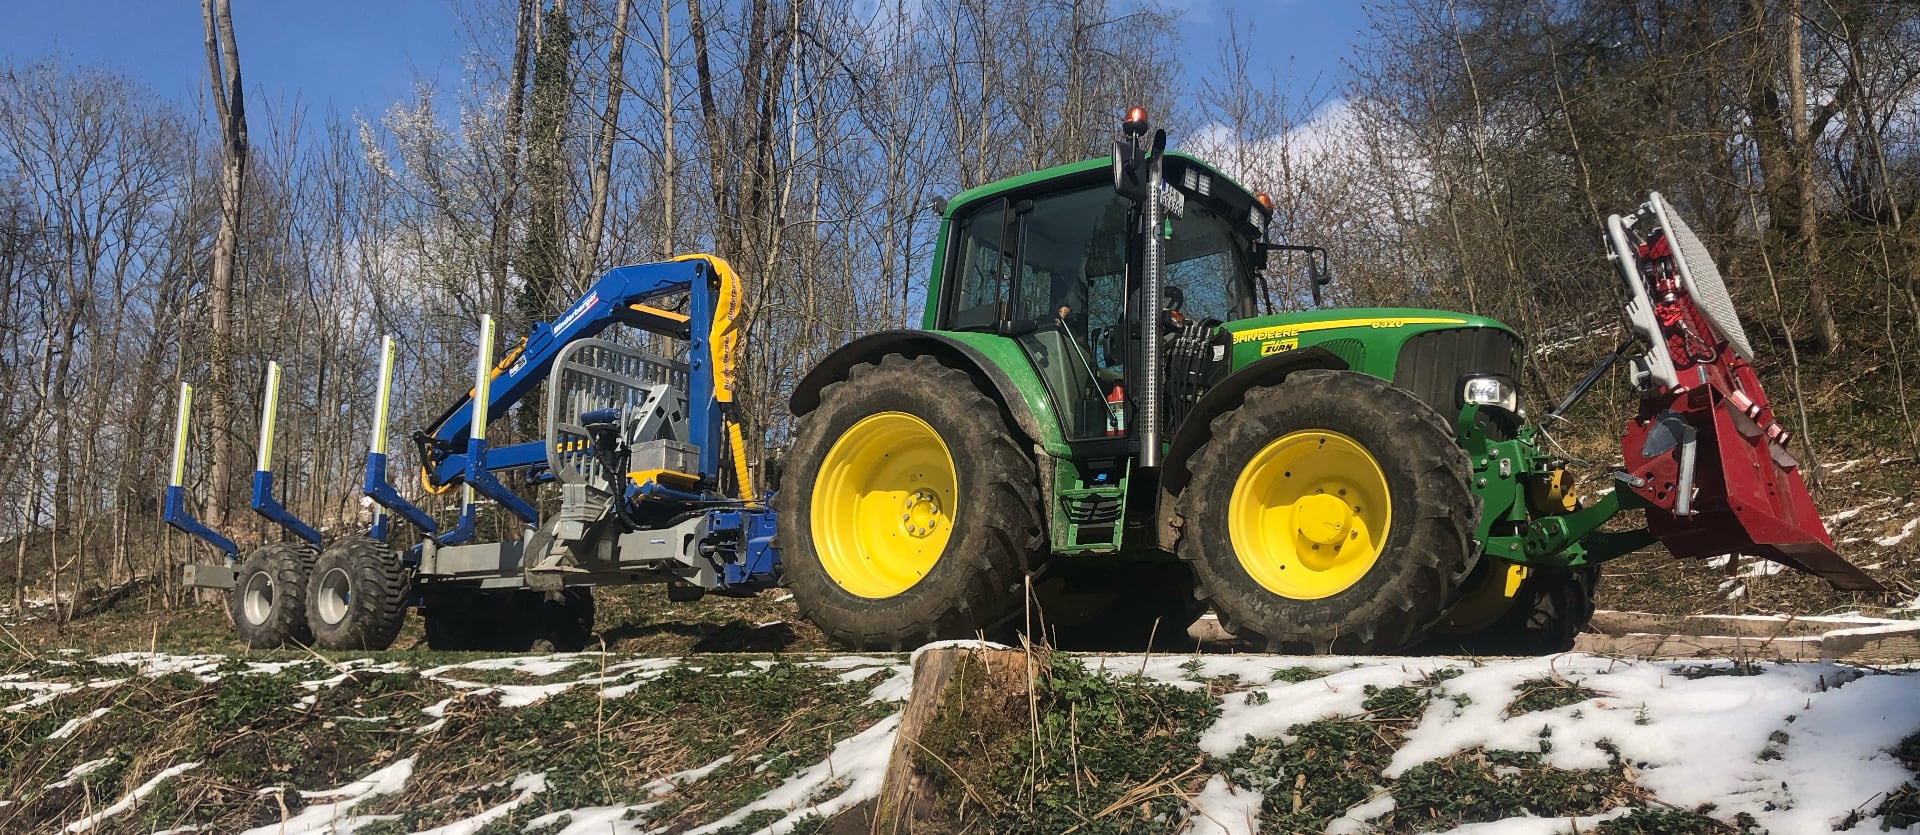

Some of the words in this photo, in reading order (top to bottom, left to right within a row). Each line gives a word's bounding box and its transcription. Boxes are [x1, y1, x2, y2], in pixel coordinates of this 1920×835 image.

[553, 290, 598, 335] Binderberger
[1371, 319, 1404, 329] 6320
[1232, 333, 1257, 345] OHN
[1258, 328, 1299, 341] DEERE
